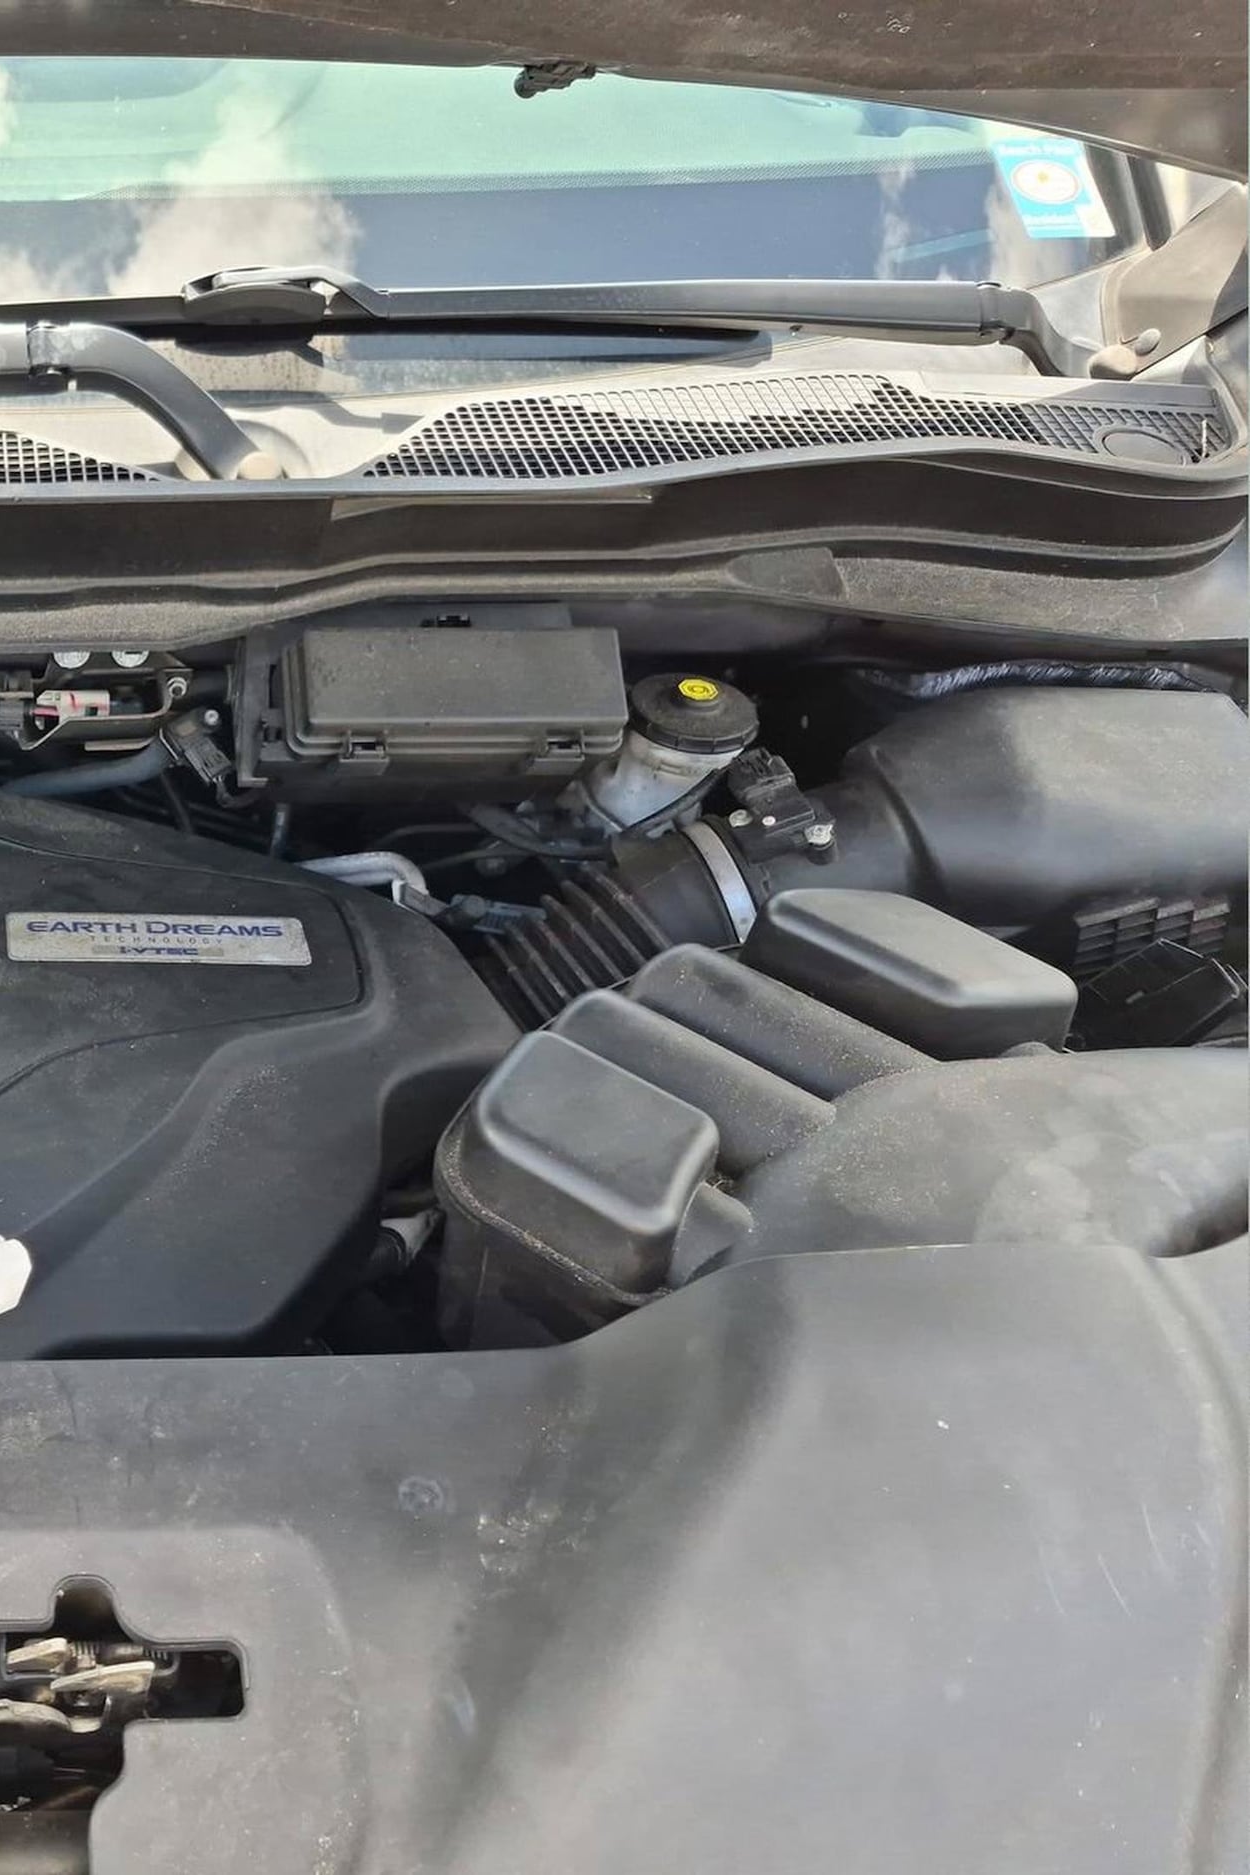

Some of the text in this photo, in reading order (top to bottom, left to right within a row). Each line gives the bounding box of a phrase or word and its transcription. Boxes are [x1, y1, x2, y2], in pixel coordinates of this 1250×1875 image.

[26, 921, 283, 937] EARTH DREAMS
[91, 935, 222, 945] TECHNOLOGY
